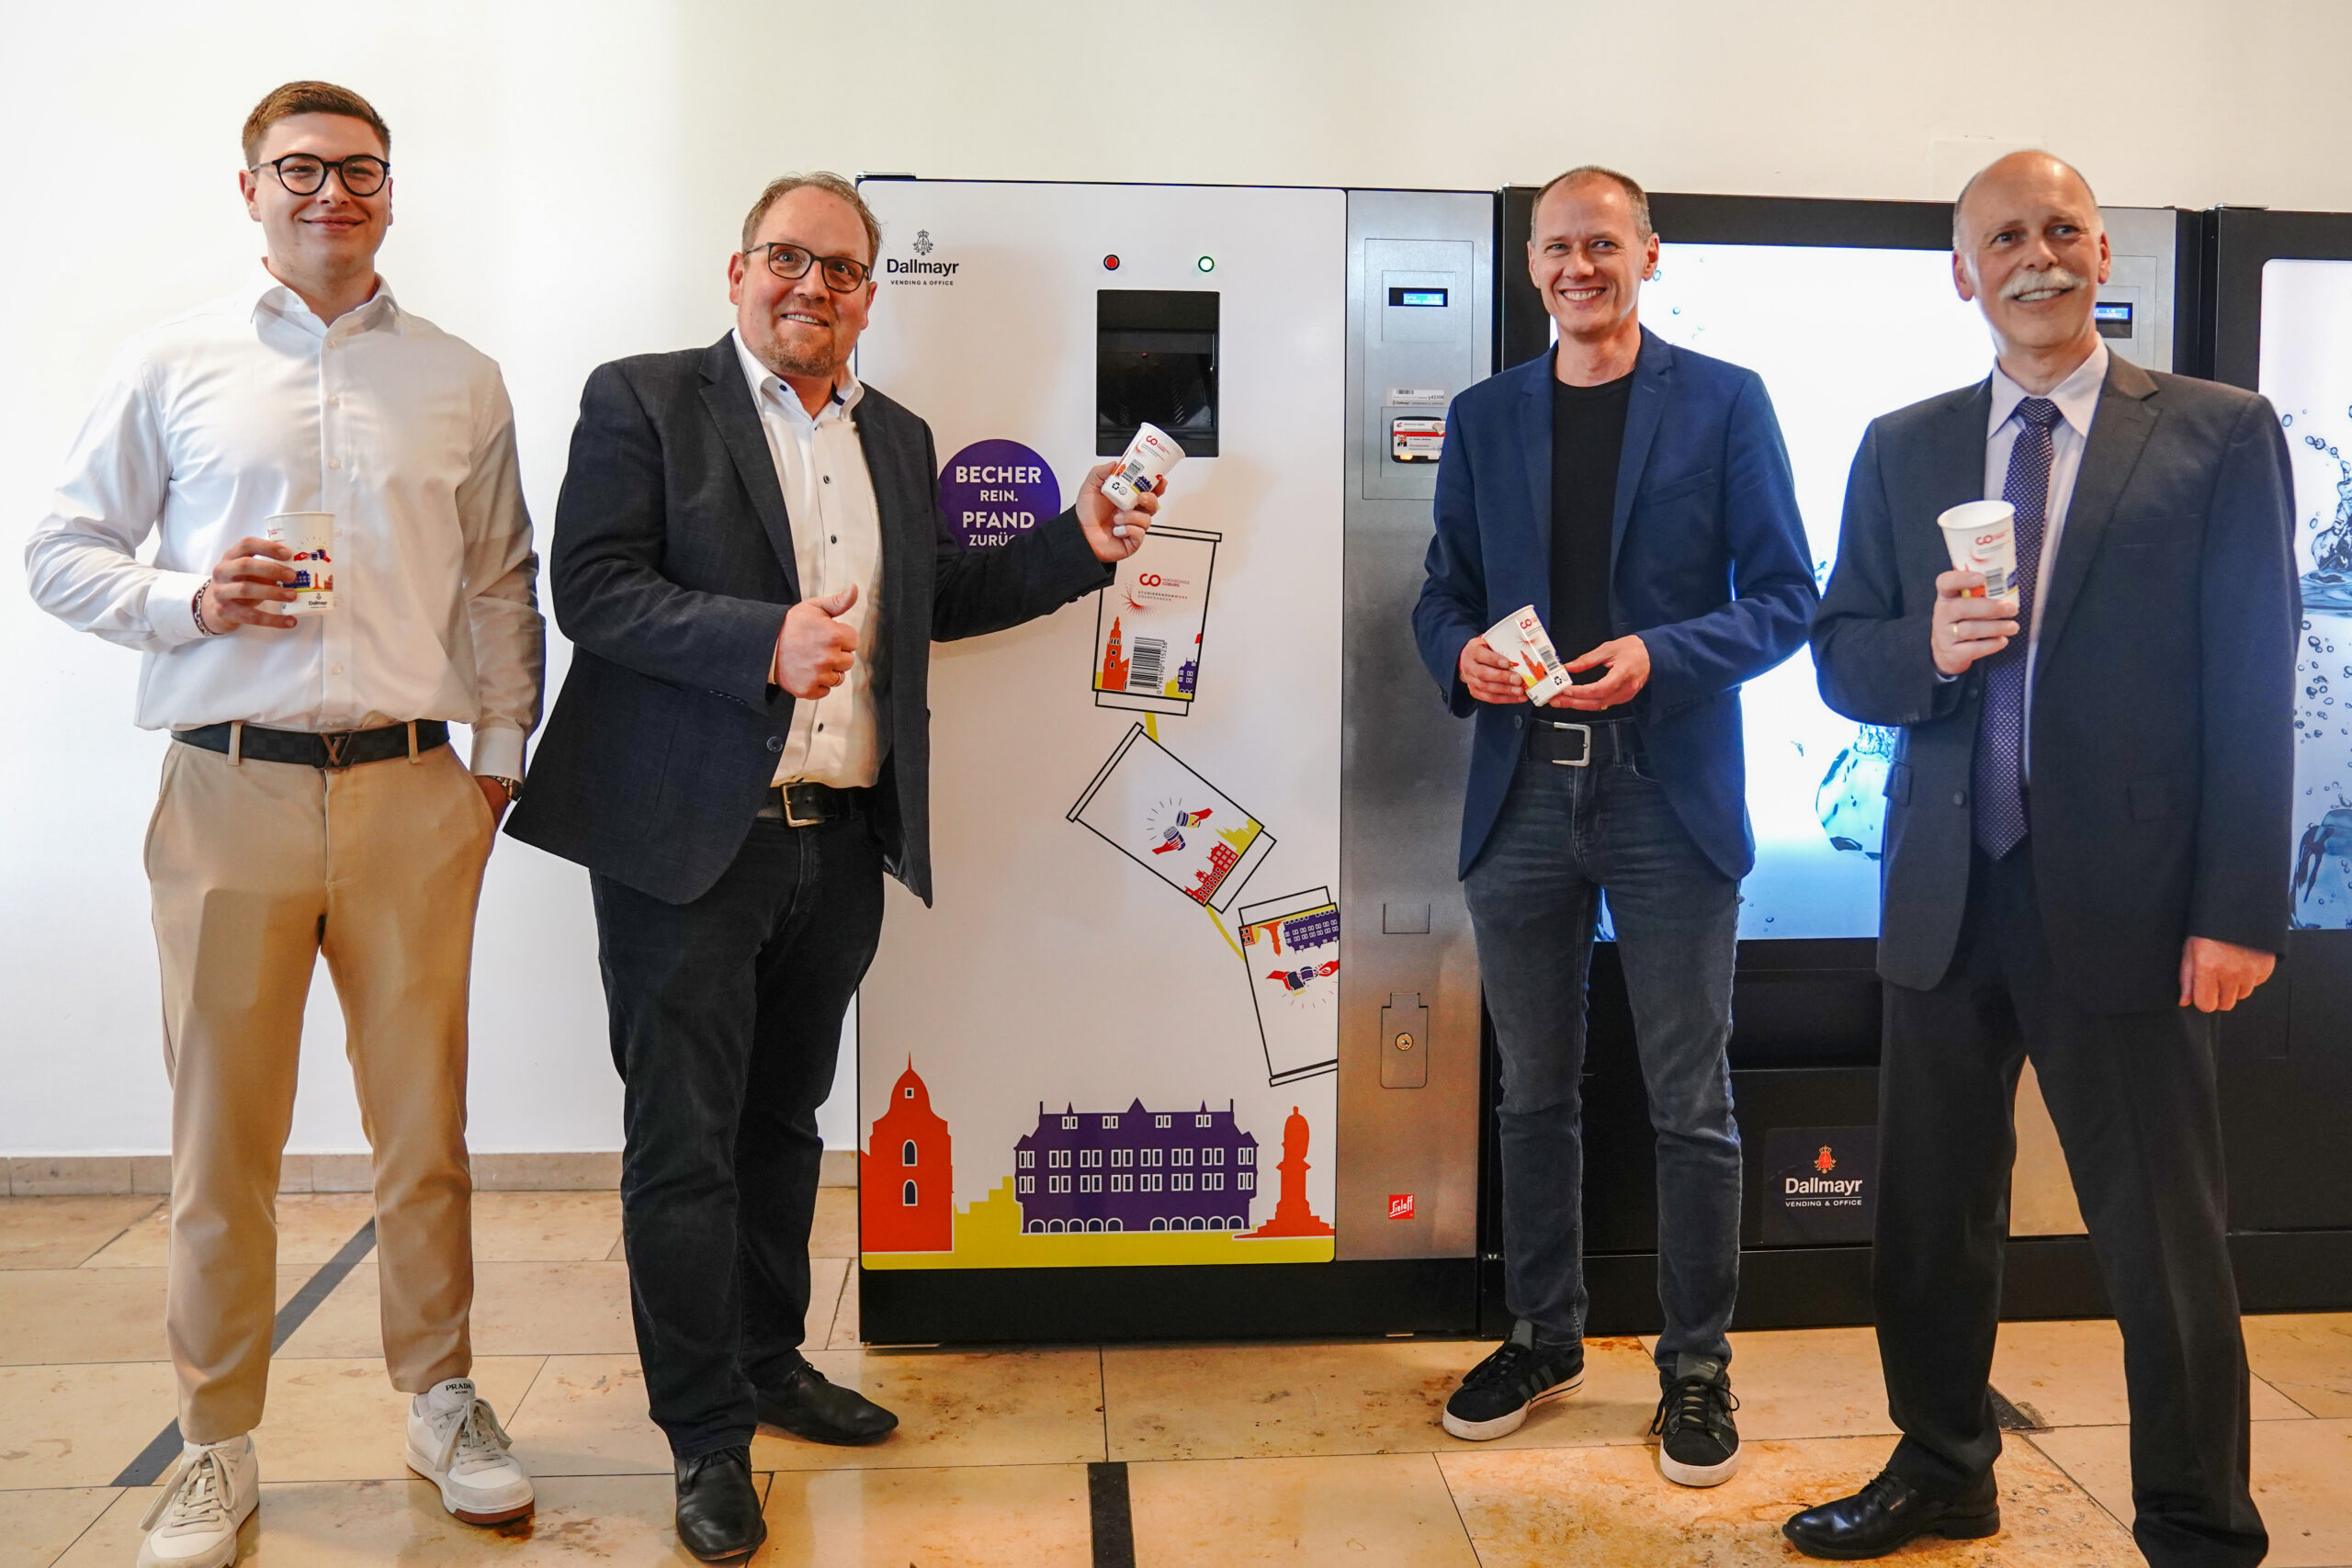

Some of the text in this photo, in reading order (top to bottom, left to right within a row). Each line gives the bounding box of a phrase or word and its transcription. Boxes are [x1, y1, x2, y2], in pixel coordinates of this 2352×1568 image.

[887, 258, 959, 277] Dallmayr
[956, 466, 1042, 484] BECHER
[979, 490, 1019, 502] REIN.
[962, 511, 1035, 529] PFAND
[968, 531, 1016, 547] ZURÜ
[1785, 1177, 1863, 1196] Dallmayr
[446, 1382, 472, 1391] PRADA
